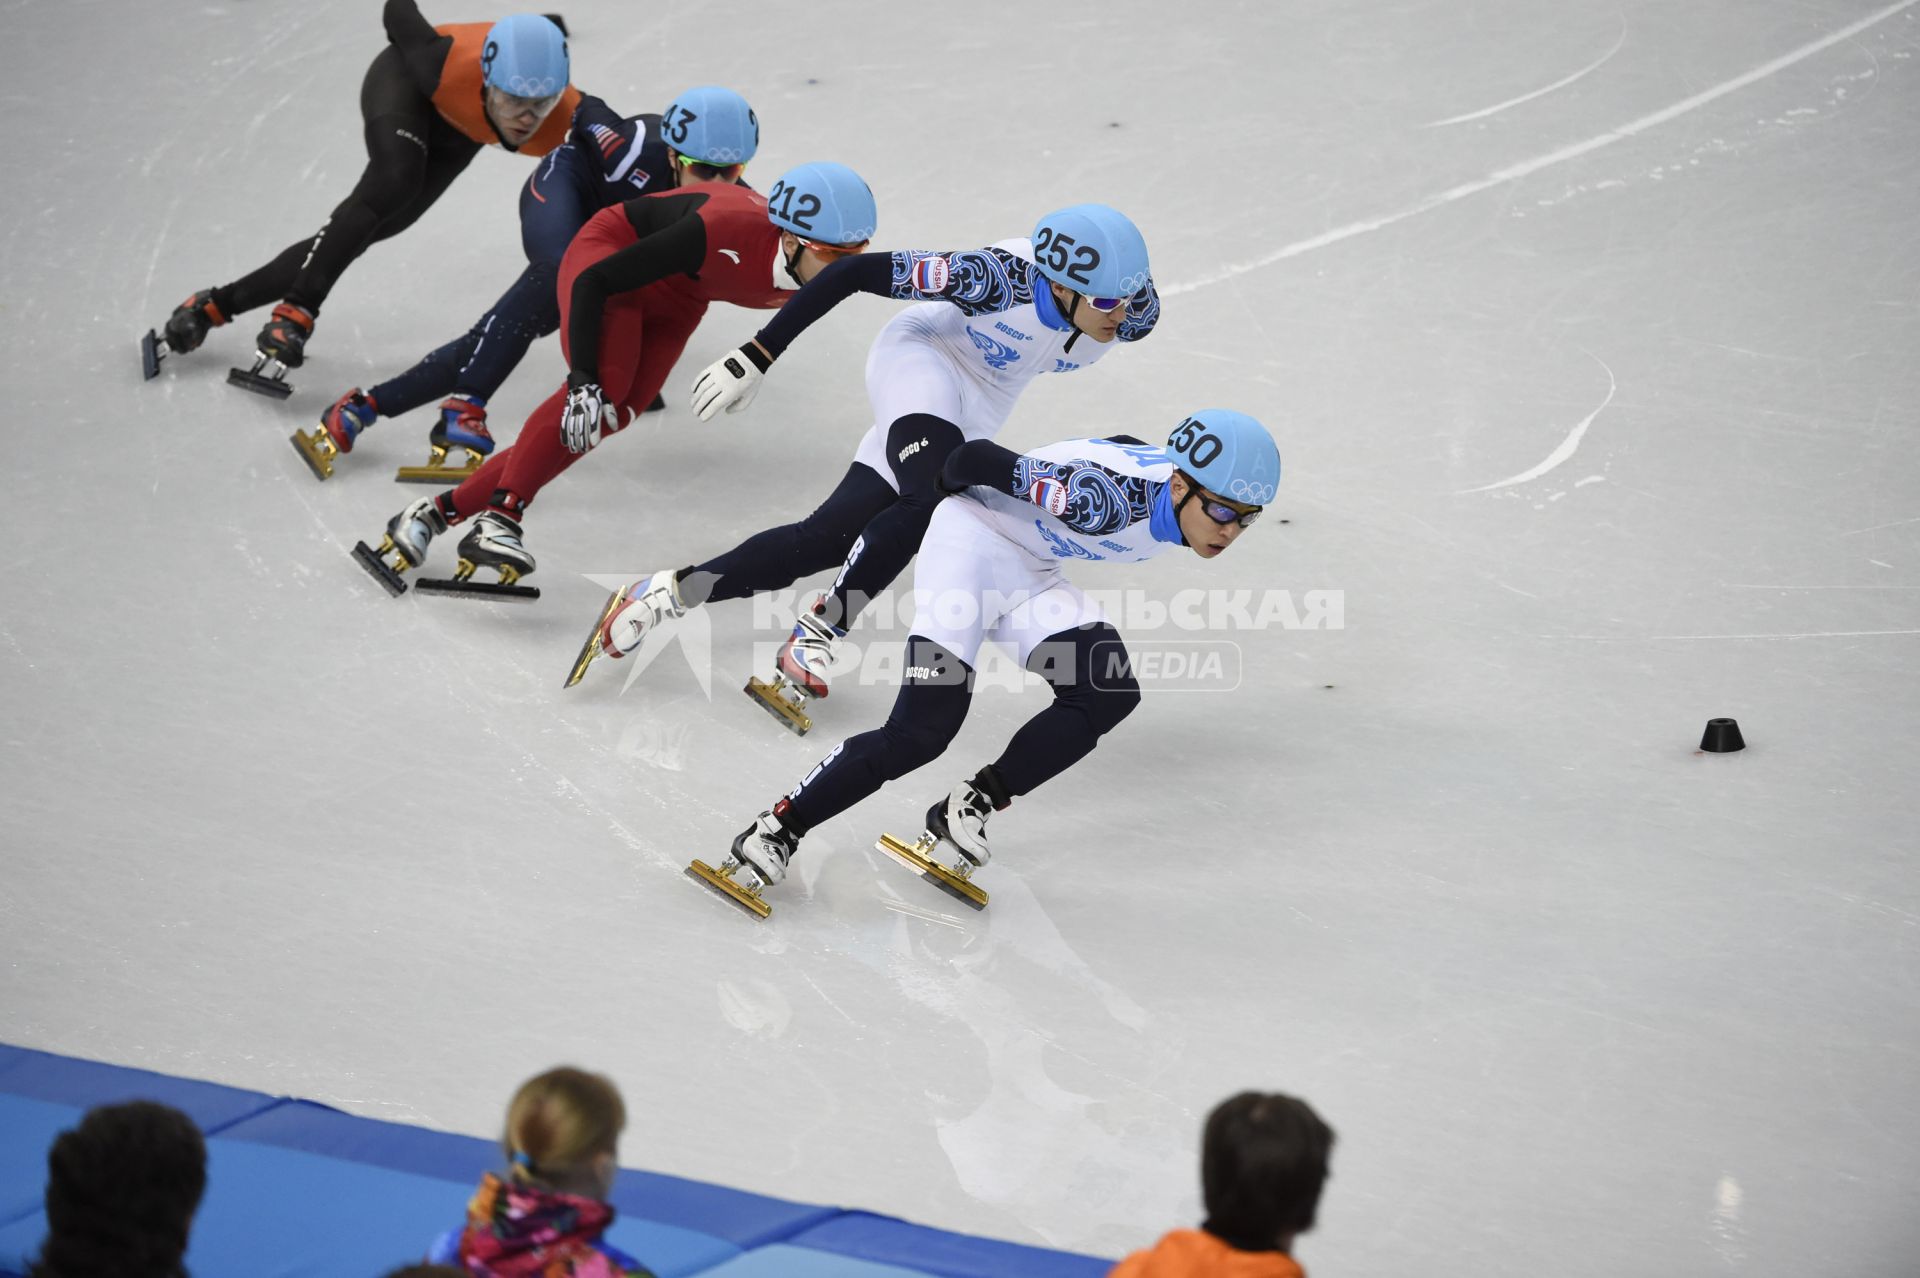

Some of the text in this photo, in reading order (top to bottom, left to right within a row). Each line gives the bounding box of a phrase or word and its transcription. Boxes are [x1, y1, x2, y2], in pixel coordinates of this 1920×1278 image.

[768, 180, 821, 231] 212
[1034, 227, 1100, 286] 252
[934, 260, 943, 289] RUSSIA
[994, 321, 1025, 341] BOSCO
[898, 441, 920, 464] BOSCO
[1098, 539, 1127, 553] BOSCO
[905, 666, 930, 680] BOSCO
